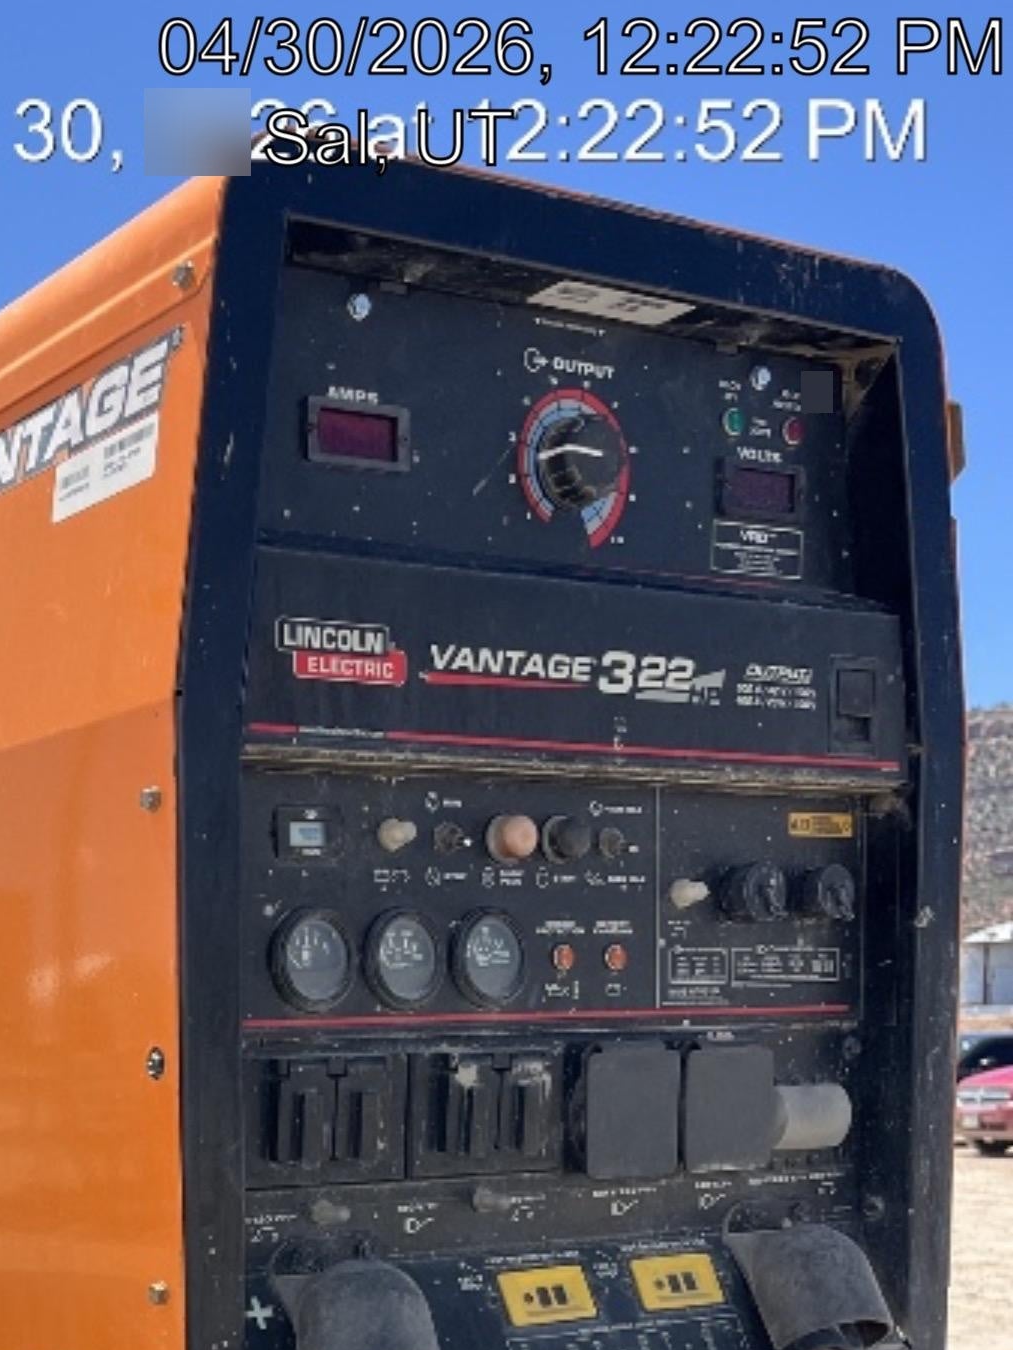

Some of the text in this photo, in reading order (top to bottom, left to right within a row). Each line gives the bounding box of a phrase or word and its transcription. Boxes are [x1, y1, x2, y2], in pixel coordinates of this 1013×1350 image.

[552, 356, 616, 380] OUTPUT
[283, 623, 385, 655] LINCOLN
[307, 655, 394, 680] ELECTRIC
[429, 643, 595, 682] VANTAGE
[596, 650, 697, 696] 322
